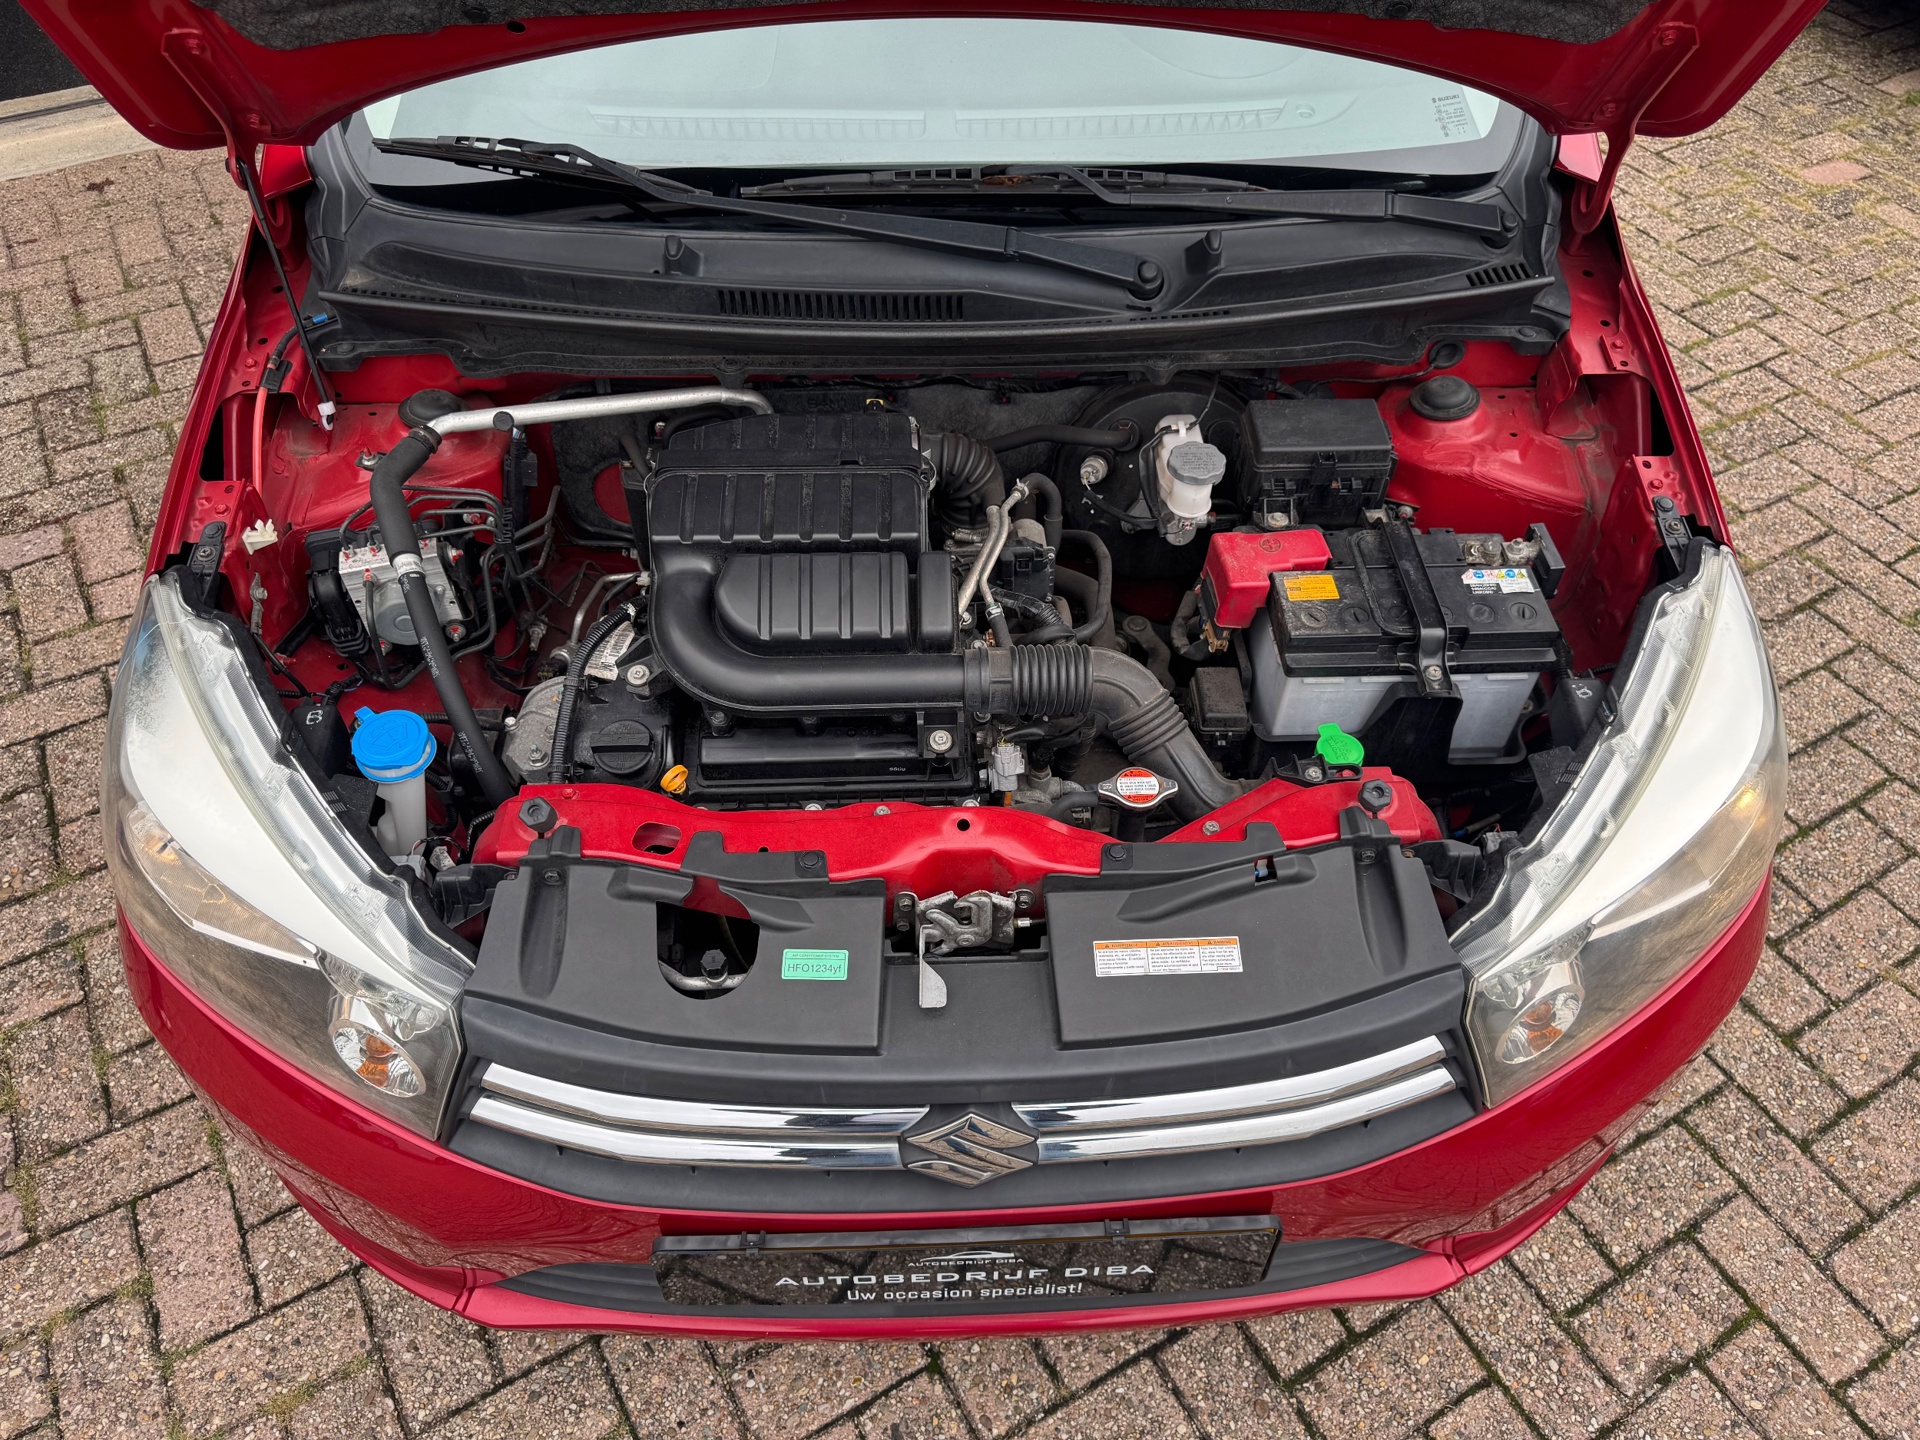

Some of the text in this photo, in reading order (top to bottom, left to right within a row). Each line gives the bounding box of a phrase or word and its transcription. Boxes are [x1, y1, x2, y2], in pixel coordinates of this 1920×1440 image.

[1437, 94, 1460, 102] SUZUKI
[787, 963, 842, 975] HFO1234yf
[907, 1259, 992, 1267] AUTOBEDRIJF
[775, 1263, 1155, 1287] AUTOBEDRIJF DIBA
[847, 1282, 1083, 1301] Uw occasion specialist!
